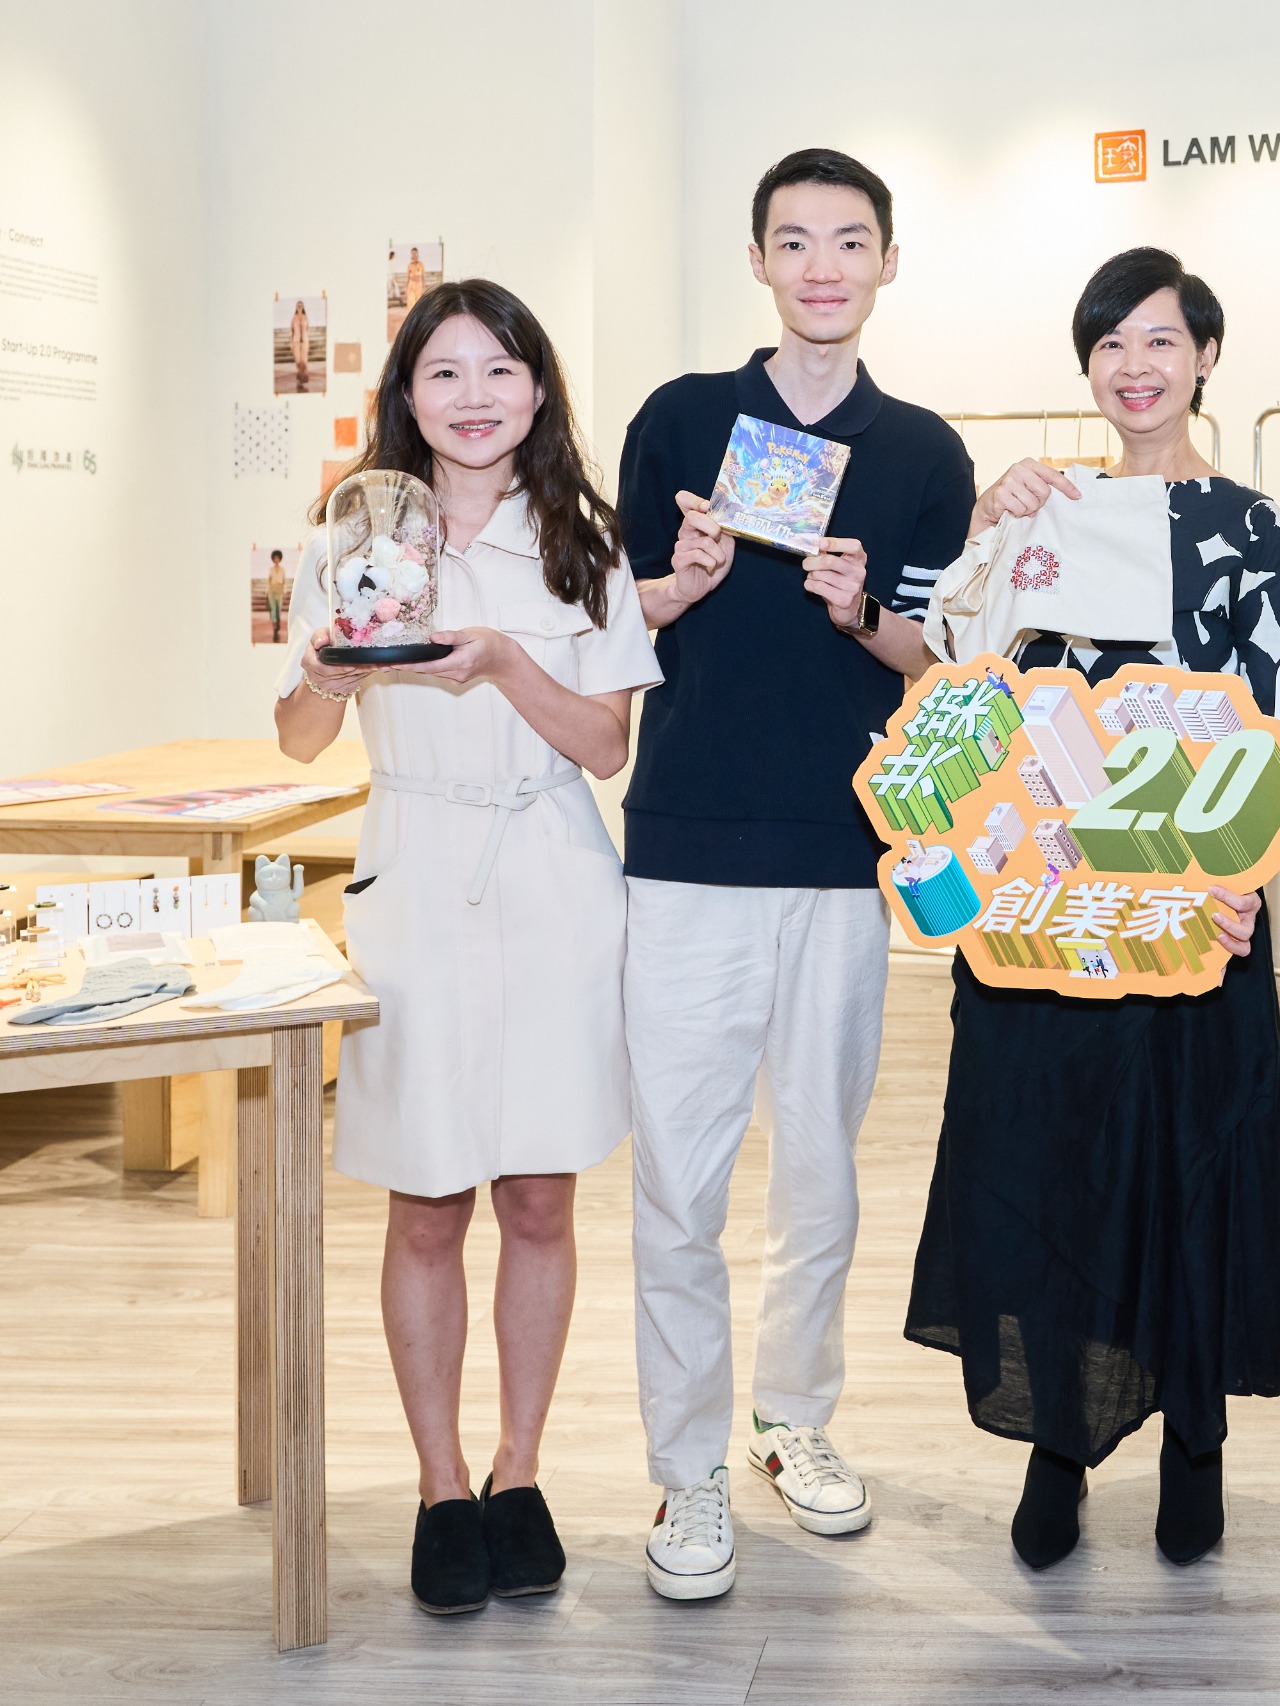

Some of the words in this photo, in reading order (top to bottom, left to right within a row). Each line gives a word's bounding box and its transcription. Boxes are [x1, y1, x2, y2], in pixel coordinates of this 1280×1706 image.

[1163, 136, 1235, 166] LAM
[8, 228, 44, 248] Connect
[1, 338, 38, 357] Start-Up
[53, 346, 98, 365] Programme
[1067, 726, 1280, 836] 2.0
[973, 876, 1210, 945] 創業家
